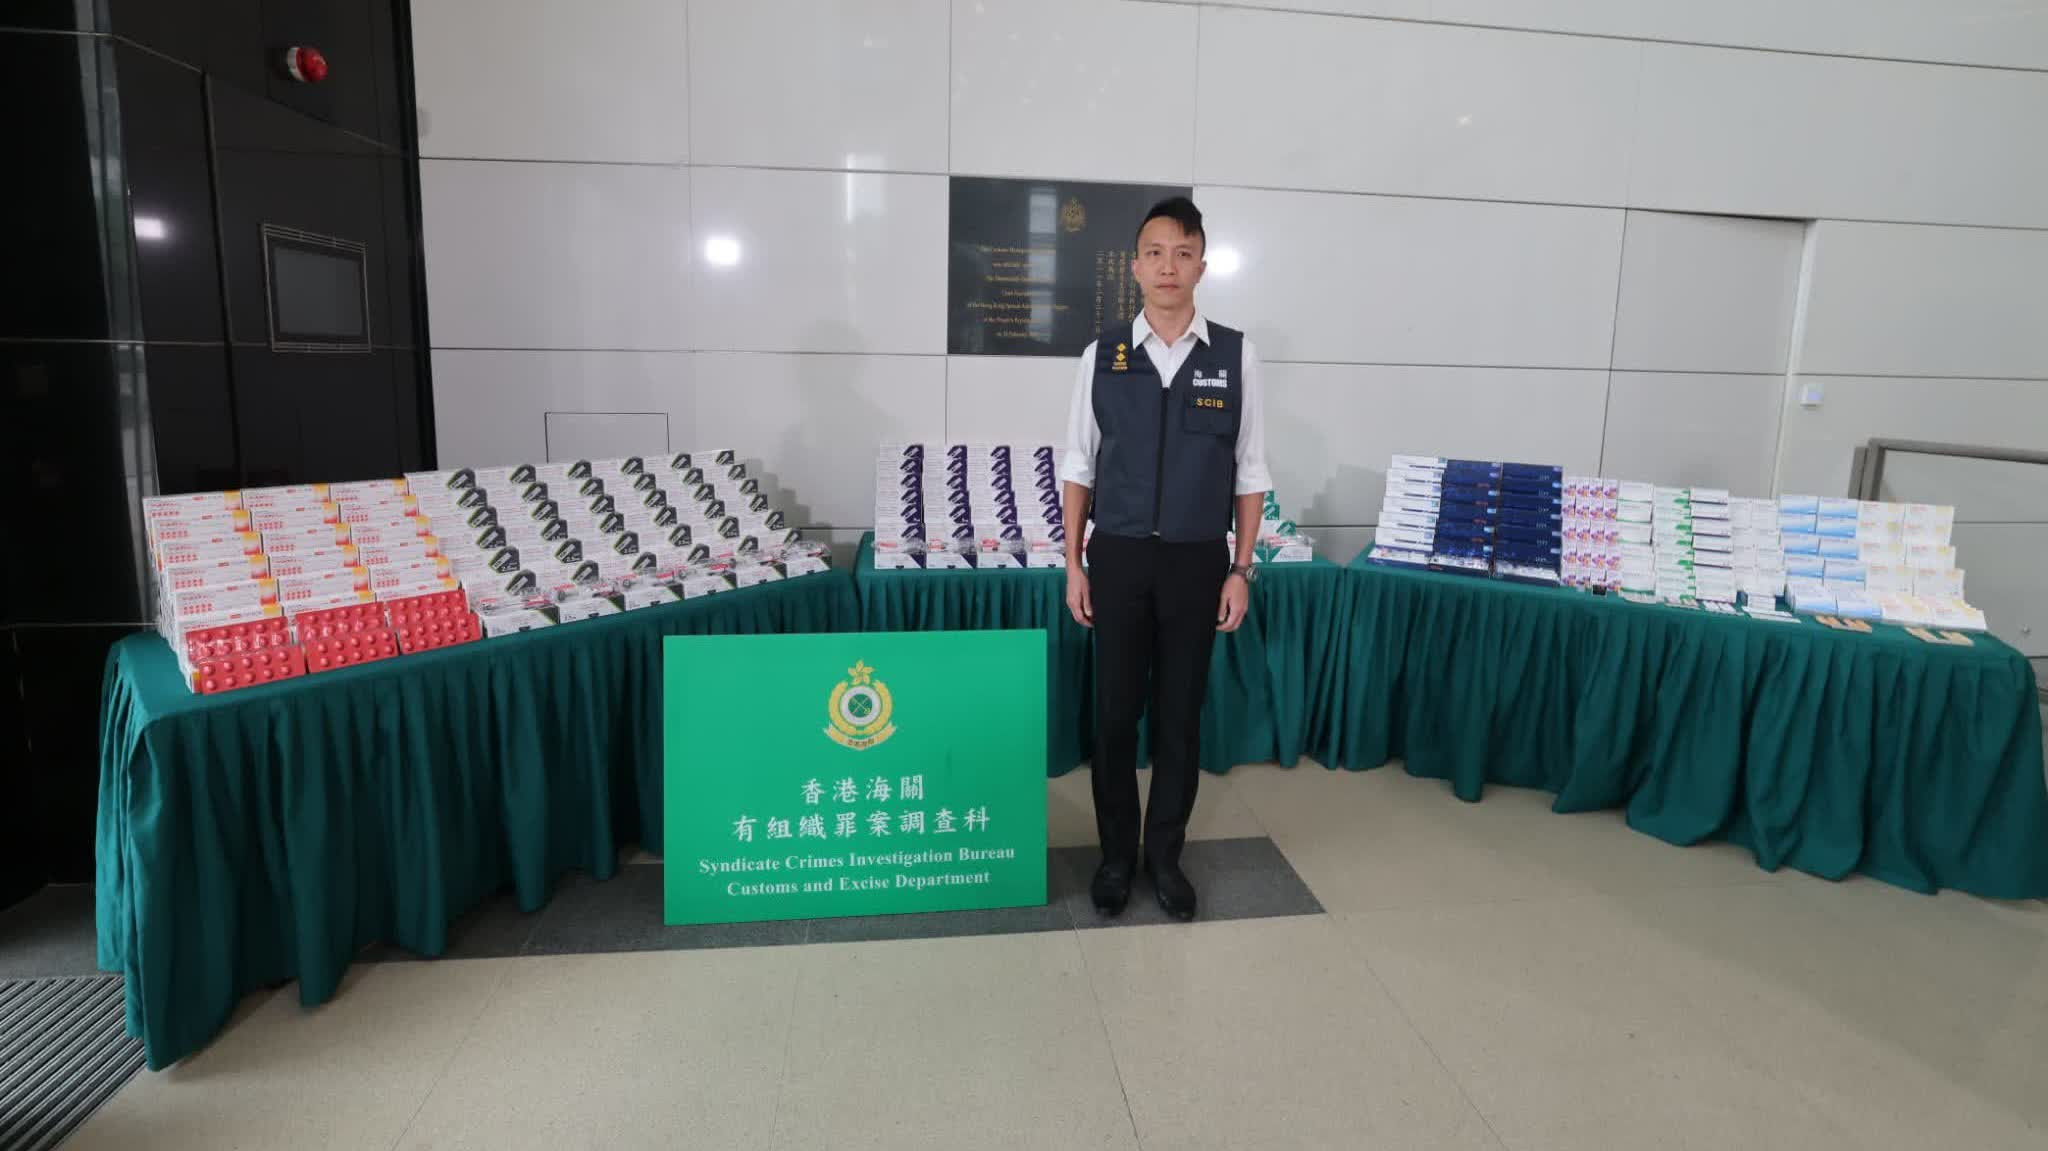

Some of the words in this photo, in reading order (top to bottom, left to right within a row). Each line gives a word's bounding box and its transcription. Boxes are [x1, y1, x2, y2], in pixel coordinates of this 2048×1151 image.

[1192, 378, 1228, 388] CUSTOMS
[1196, 398, 1224, 408] SCIB
[800, 774, 925, 804] 香港海關
[732, 806, 991, 842] 有組織罪案調查科
[699, 857, 780, 876] Syndicate
[785, 855, 844, 870] Crimes
[850, 849, 953, 868] Investigation
[959, 847, 1015, 861] Bureau
[727, 880, 799, 896] Customs
[803, 878, 833, 893] and
[839, 876, 890, 891] Excise
[895, 871, 991, 890] Department
